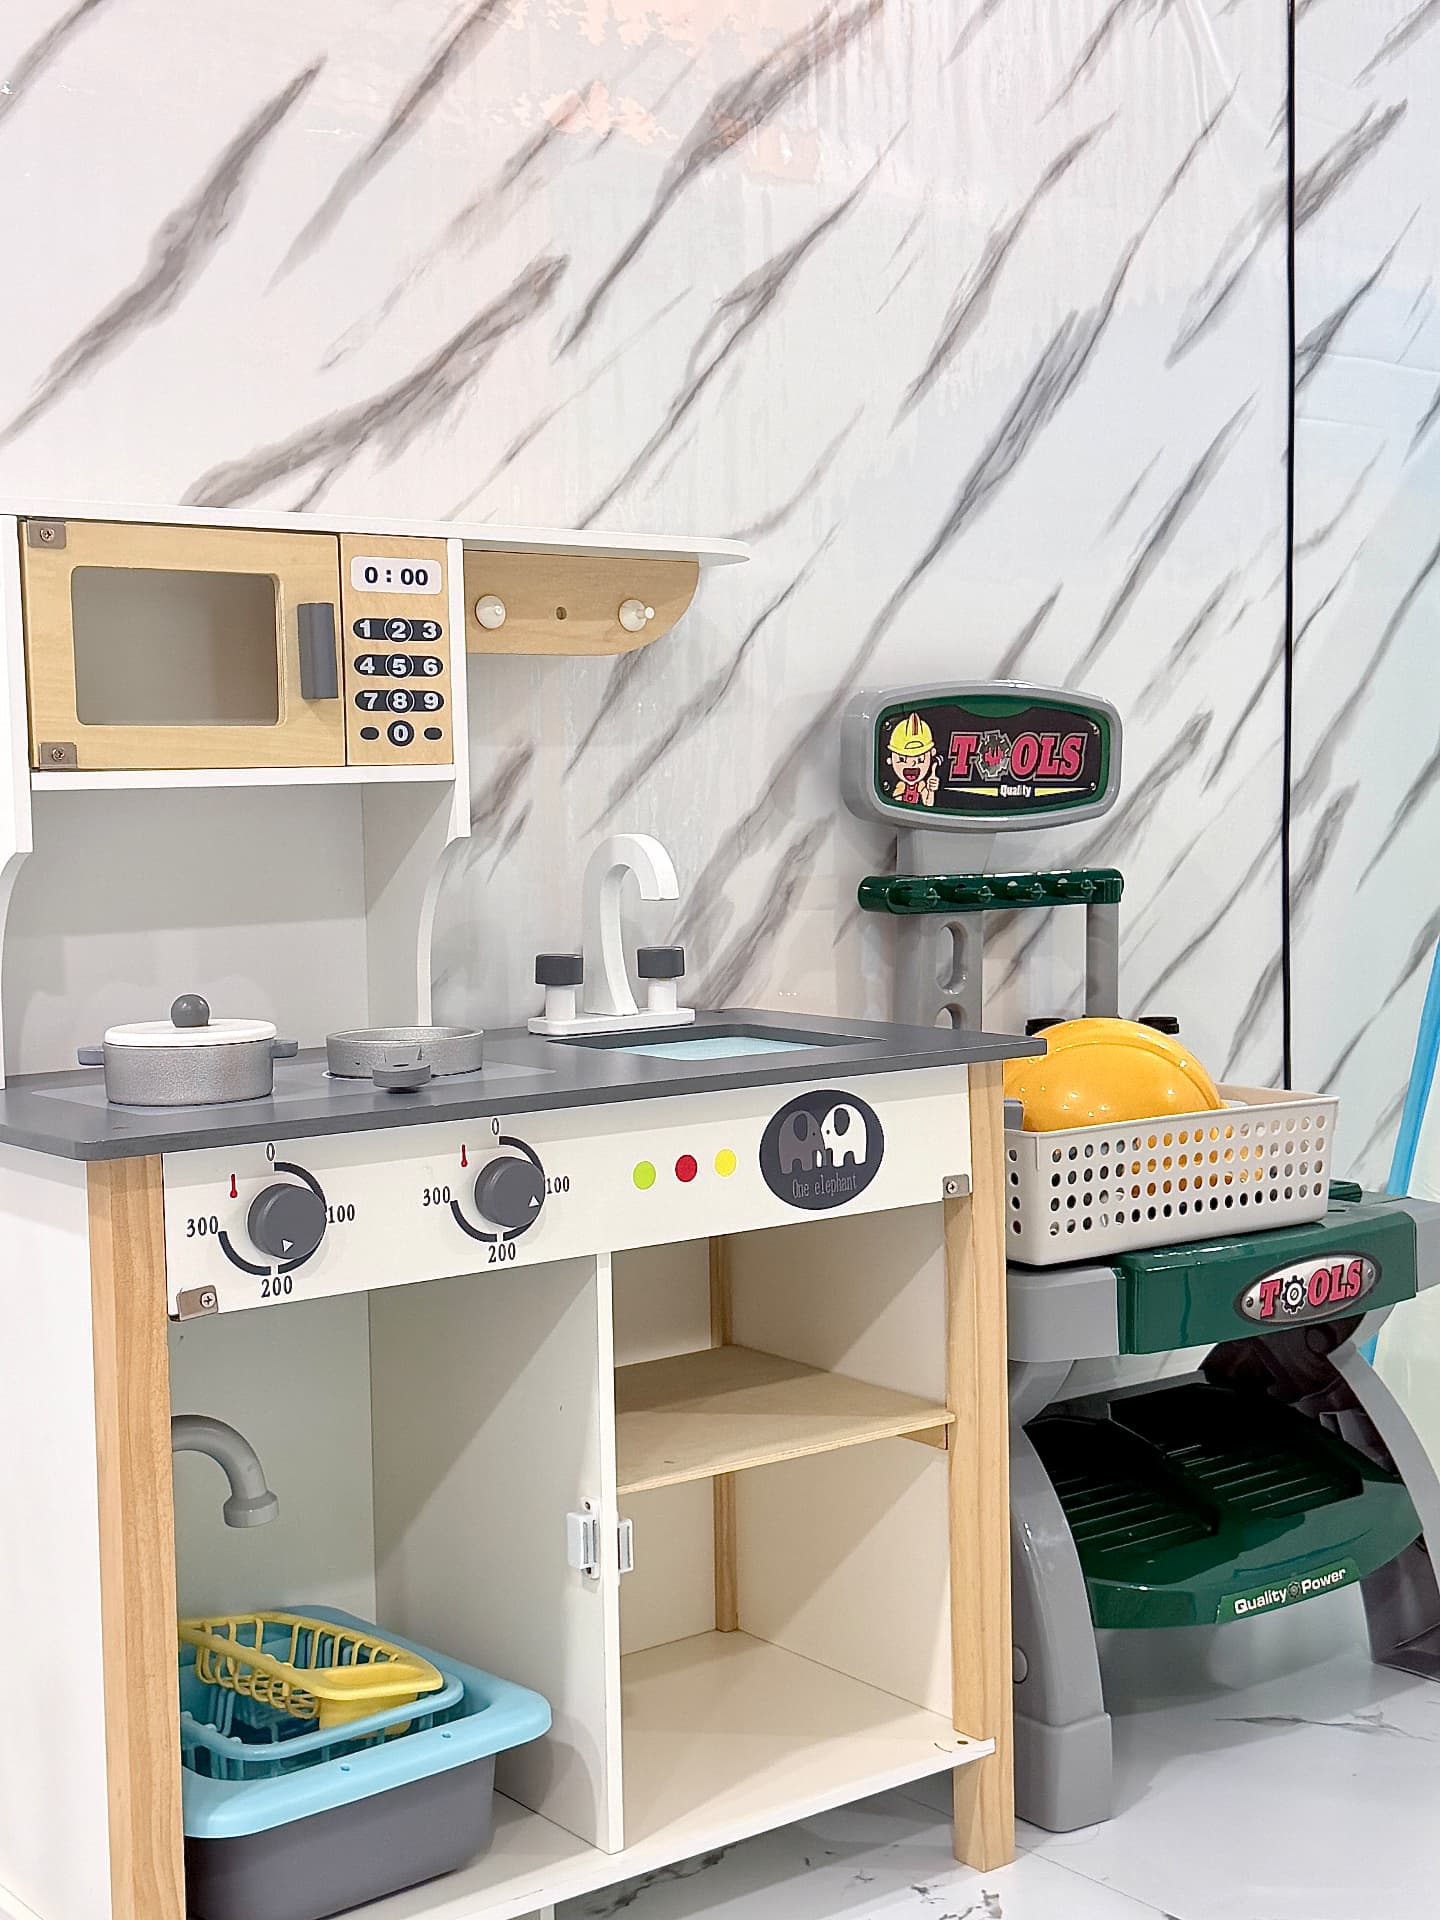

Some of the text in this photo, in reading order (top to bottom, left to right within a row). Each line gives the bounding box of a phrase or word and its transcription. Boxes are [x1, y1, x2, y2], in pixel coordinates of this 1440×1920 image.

[359, 619, 437, 639] 1 2 3
[359, 657, 438, 675] 4 5 6
[363, 692, 439, 710] 7 8 9
[393, 724, 409, 742] 0
[949, 731, 1087, 781] TOOLS
[491, 1117, 500, 1136] 0
[266, 1143, 275, 1162] 0
[545, 1176, 570, 1195] 100
[792, 1172, 858, 1200] One elephant
[423, 1185, 451, 1207] 300
[327, 1204, 355, 1224] 100
[186, 1215, 219, 1238] 300
[488, 1243, 516, 1264] 200
[261, 1276, 293, 1298] 200
[1259, 1259, 1363, 1318] TOOLS
[1234, 1568, 1346, 1615] Quality Power
